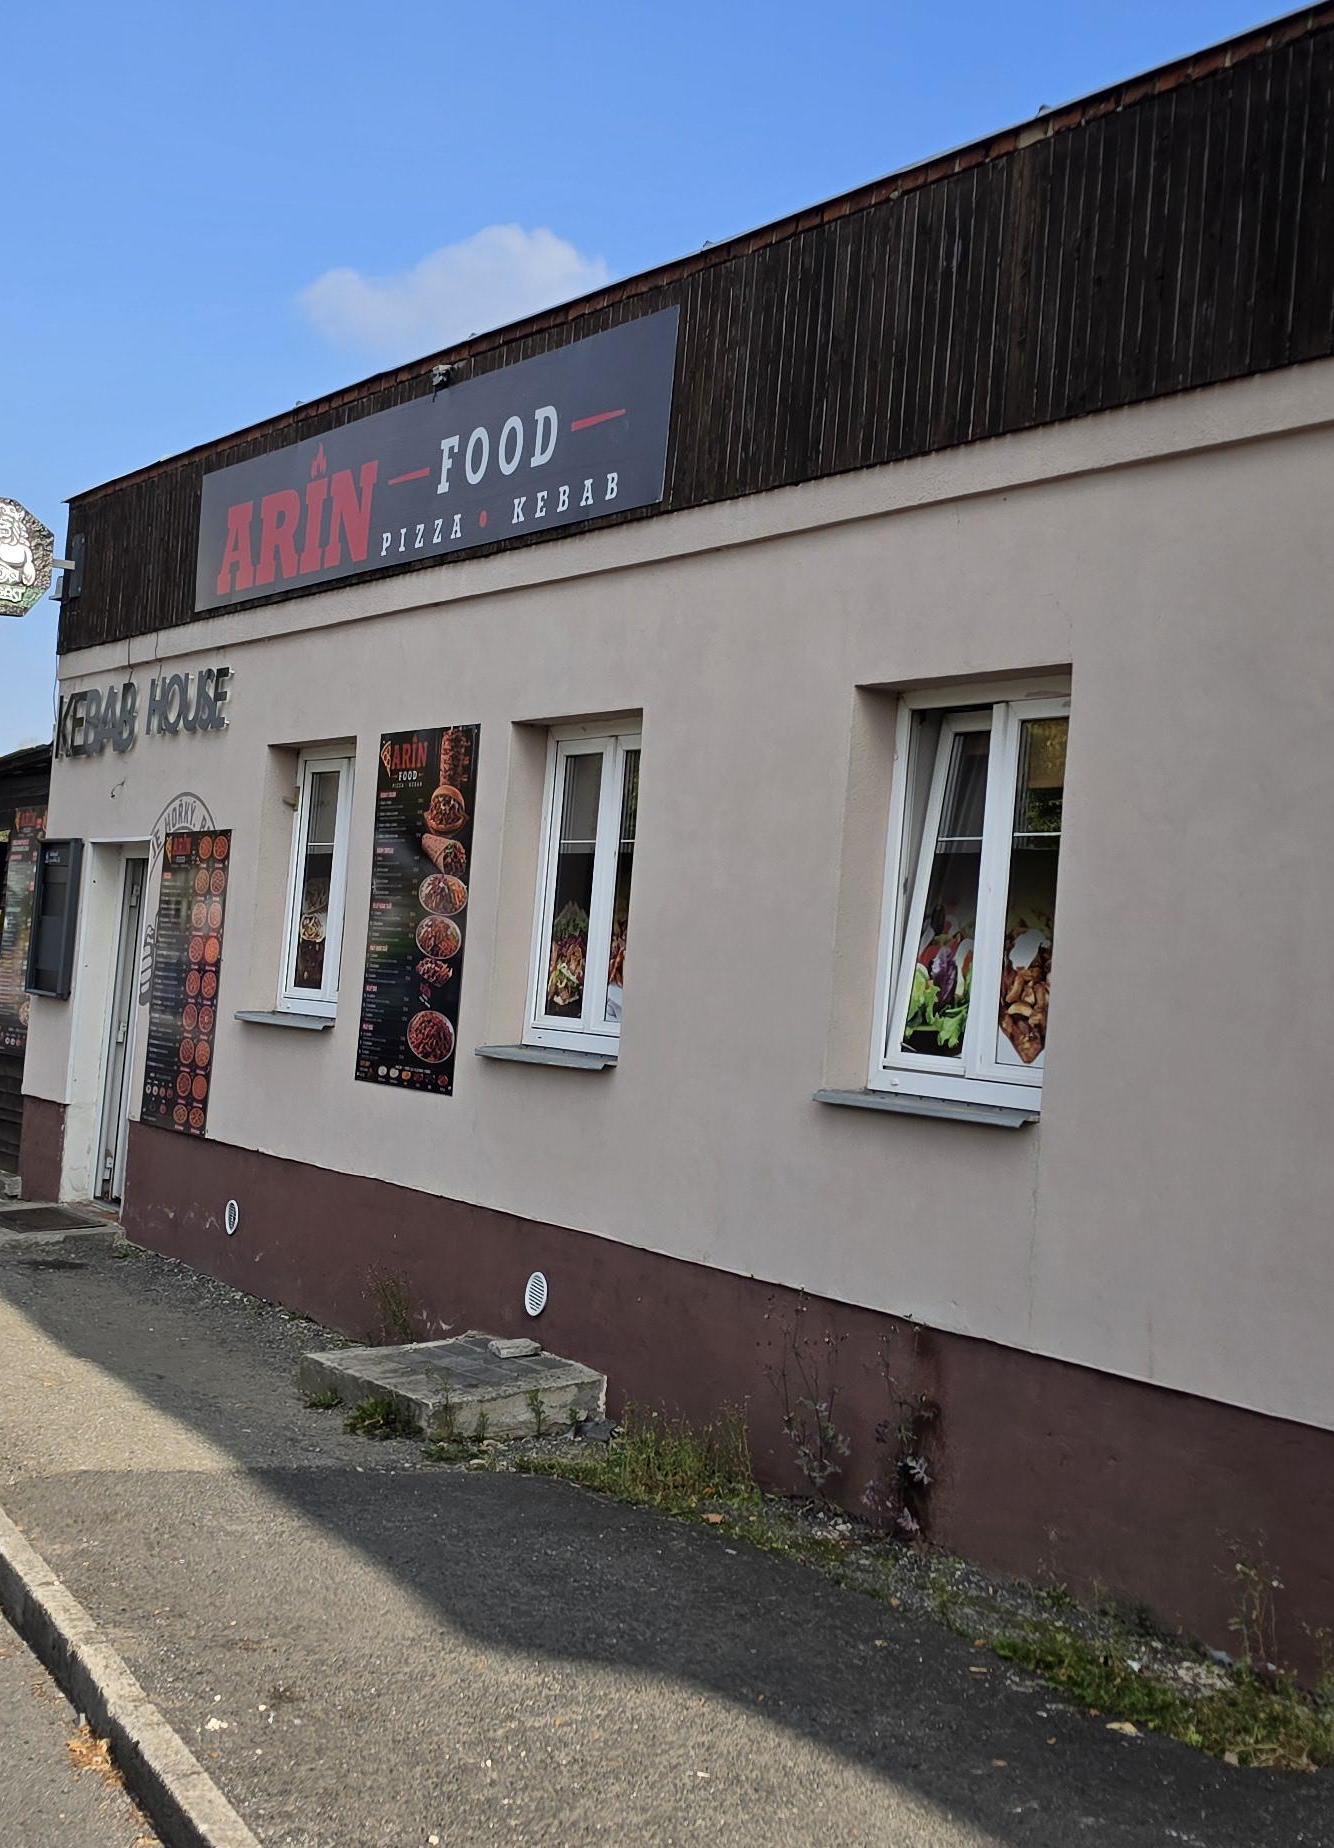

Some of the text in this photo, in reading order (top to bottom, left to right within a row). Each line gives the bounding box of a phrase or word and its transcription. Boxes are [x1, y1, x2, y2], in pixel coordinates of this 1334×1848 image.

[436, 405, 559, 494] FOOD
[380, 472, 618, 557] PIZZA KEBAB
[55, 666, 230, 759] KEBAB HOUSE
[398, 770, 418, 782] FOOD
